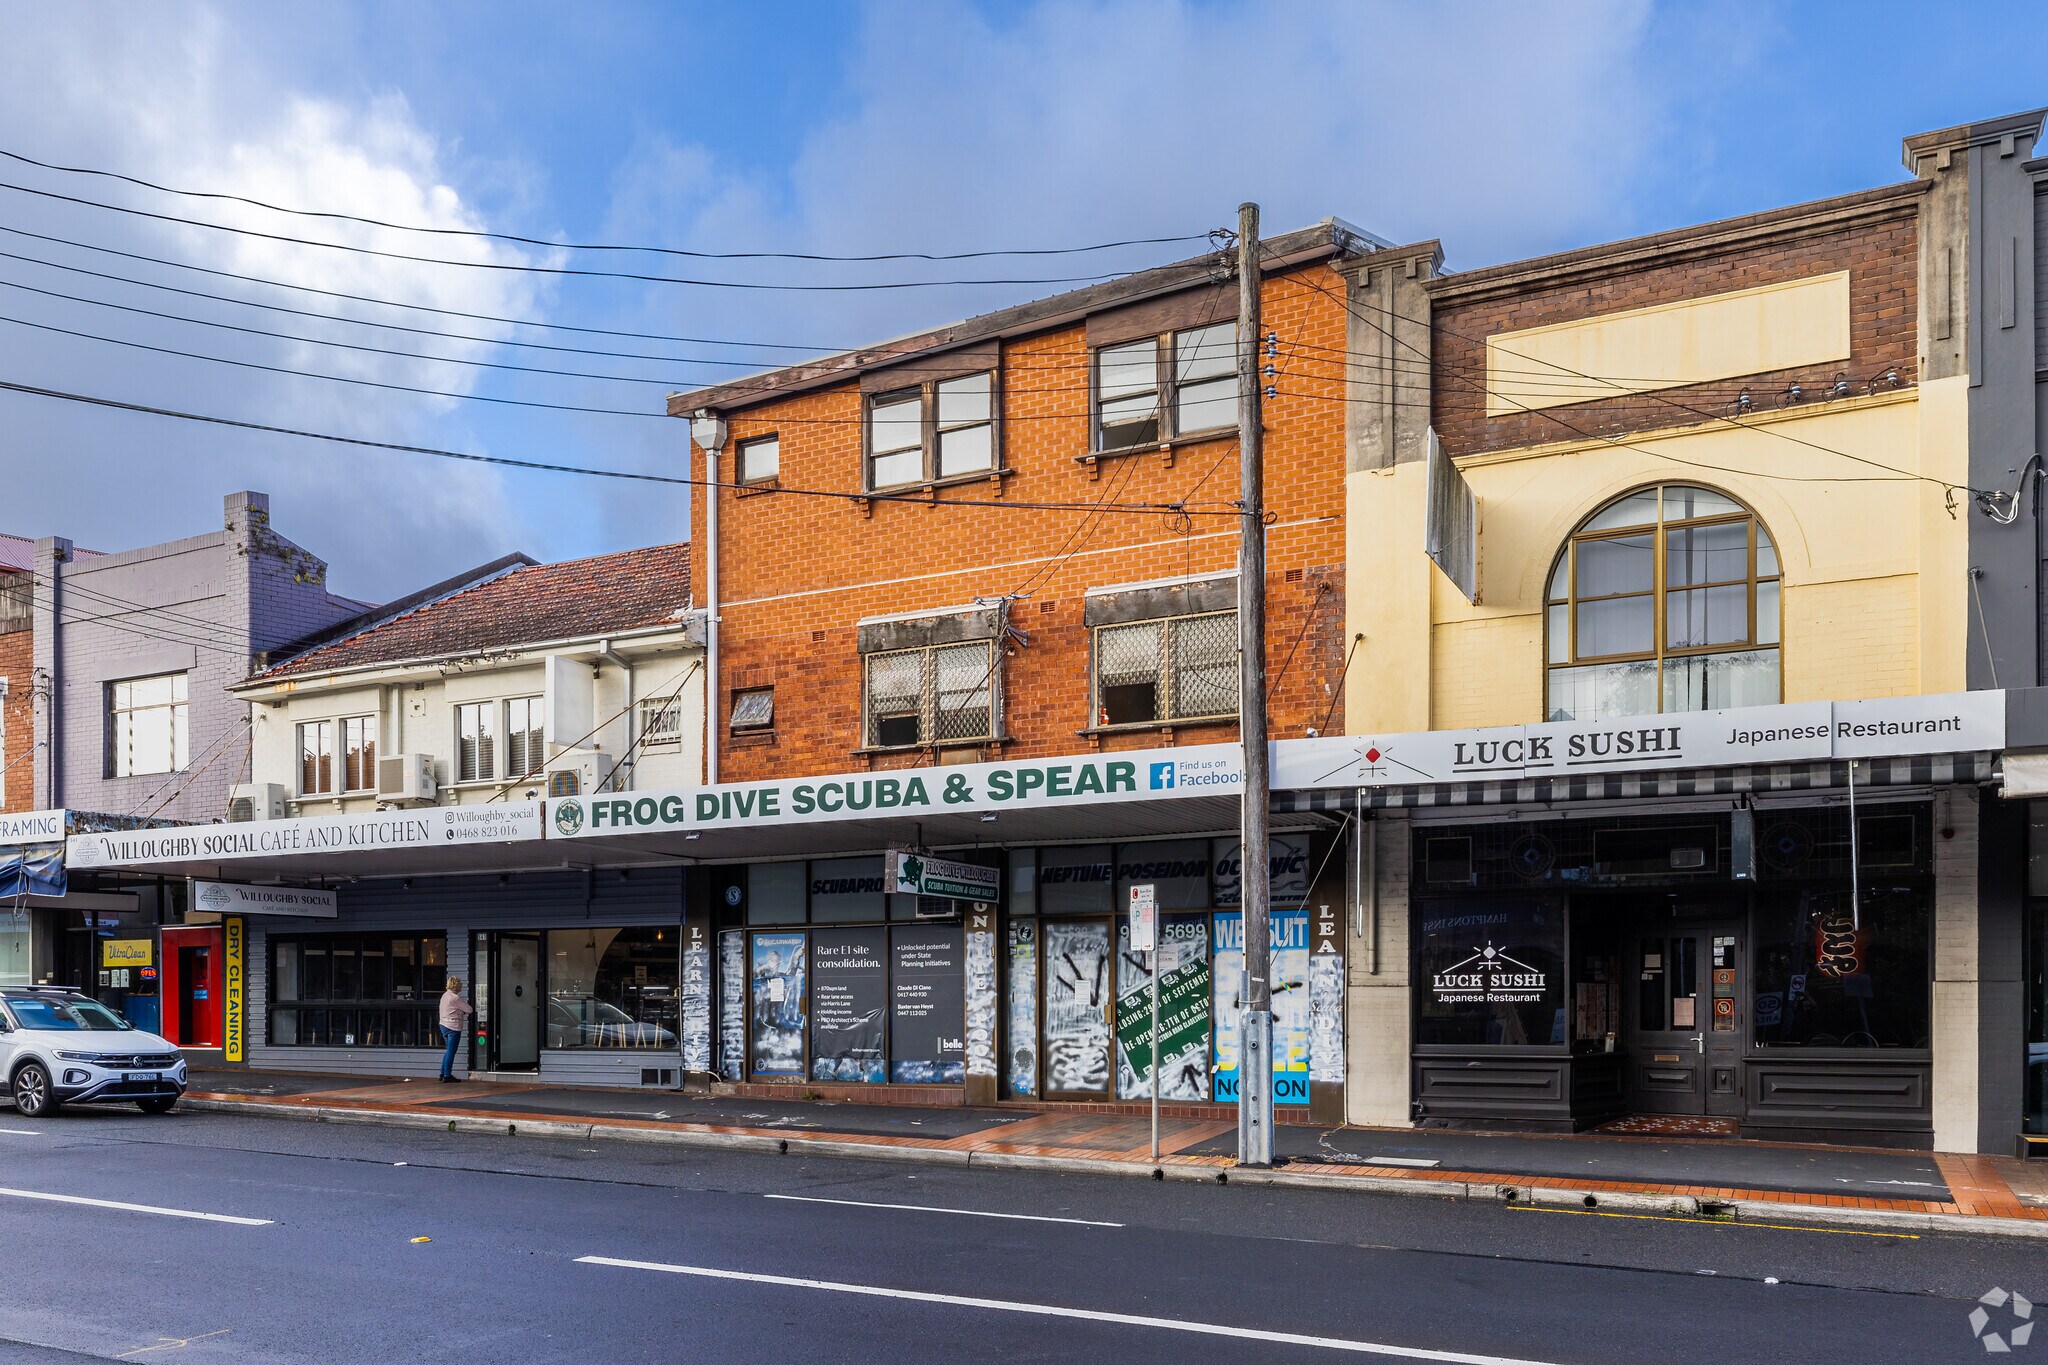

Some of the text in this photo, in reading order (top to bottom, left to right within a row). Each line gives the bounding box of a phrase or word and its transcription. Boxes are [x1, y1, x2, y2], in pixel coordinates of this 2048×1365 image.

[1726, 715, 1961, 747] Japanese Restaurant
[1453, 727, 1682, 765] LUCK SUSHI
[1179, 761, 1200, 770] Find
[1213, 760, 1227, 768] on
[591, 795, 684, 828] FROG
[696, 788, 781, 821] DIVE
[792, 777, 931, 814] SCUBA
[942, 773, 975, 804] &
[987, 761, 1137, 801] SPEAR
[456, 807, 534, 824] Willoughby_social
[0, 817, 57, 837] RAMING
[456, 825, 518, 839] 0468 823 016
[100, 819, 430, 860] WILLOUGHBY SOCIAL CAFÉ AND KITCHEN
[926, 860, 998, 883] FROG DIVE WILLOUGHBY
[1041, 864, 1112, 884] NEPTUNE
[1117, 860, 1208, 881] POSEIDON
[1216, 856, 1308, 877] OCNIC
[812, 877, 884, 895] SCUBAPRO
[927, 881, 944, 891] SCUBA
[945, 883, 964, 894] TUITION
[969, 887, 982, 896] GEAR
[982, 888, 995, 897] SALES
[235, 888, 300, 904] WILLOUGHBY
[301, 895, 332, 906] SOCIAL
[1165, 923, 1206, 939] 5699
[1214, 917, 1308, 949] WESUIT
[229, 925, 240, 959] DRY
[817, 945, 870, 955] Rare E1 site
[926, 943, 951, 951] potential
[817, 958, 881, 969] consolidation.
[901, 960, 924, 968] Planning
[140, 969, 157, 977] OPEN
[1433, 974, 1546, 987] LUCK SUSHI
[1162, 993, 1172, 1005] OF
[1438, 993, 1540, 1004] Japanese Restaurant
[229, 965, 240, 1054] CLEANING
[1180, 1008, 1190, 1019] OF
[943, 1038, 963, 1049] belle
